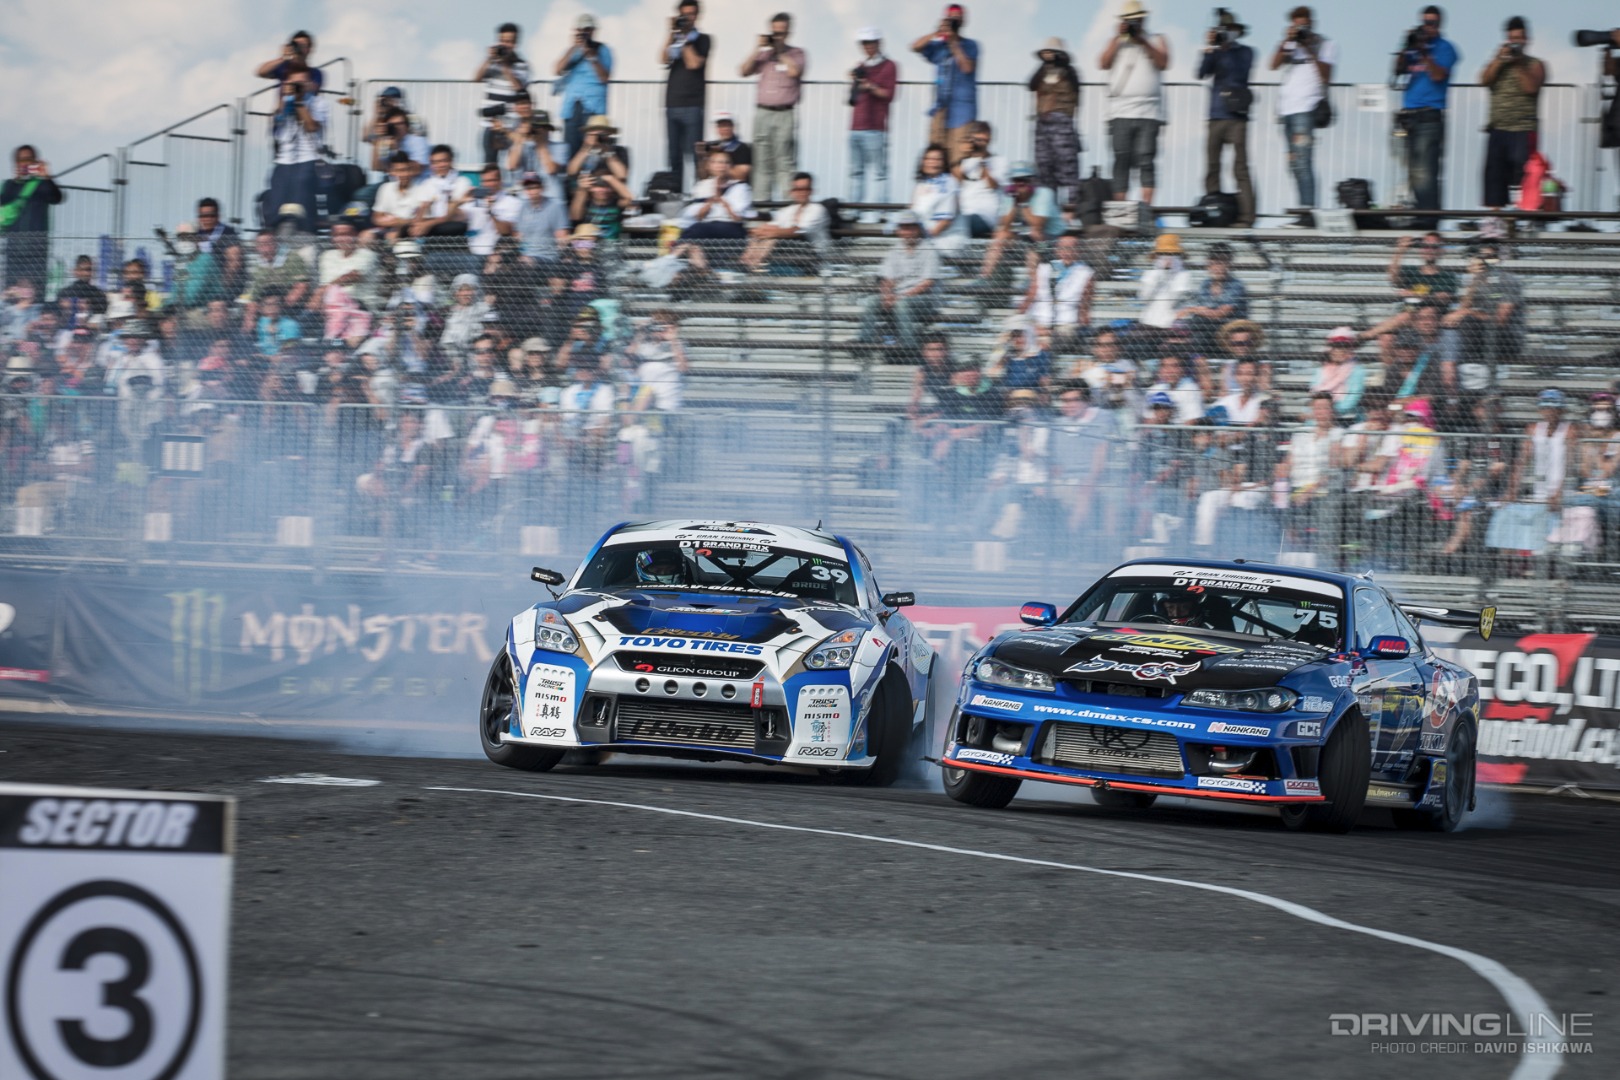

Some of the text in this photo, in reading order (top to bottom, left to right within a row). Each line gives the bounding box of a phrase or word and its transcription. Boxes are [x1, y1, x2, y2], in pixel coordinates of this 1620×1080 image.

[703, 541, 740, 550] GRAND
[742, 543, 770, 551] PRIX
[811, 565, 849, 584] 39
[792, 581, 828, 590] BRIDE
[1173, 578, 1271, 592] D1 GRAND PRIX
[1296, 609, 1338, 629] 75
[240, 603, 491, 663] MONSTER
[619, 636, 764, 655] TOYO TIRES
[657, 665, 740, 677] GLION GROUP
[541, 678, 566, 686] TRUST
[535, 692, 567, 702] nismo
[982, 699, 1021, 710] NANKANG
[1034, 705, 1196, 729] www.dmax-cs.com
[530, 727, 567, 737] RAYS
[1223, 725, 1268, 736] NANKANG
[798, 747, 838, 756] RAYS
[960, 750, 1000, 760] KOYORAD
[1199, 779, 1251, 789] KOYORAD
[18, 799, 196, 848] SECTOR
[54, 926, 156, 1070] 3
